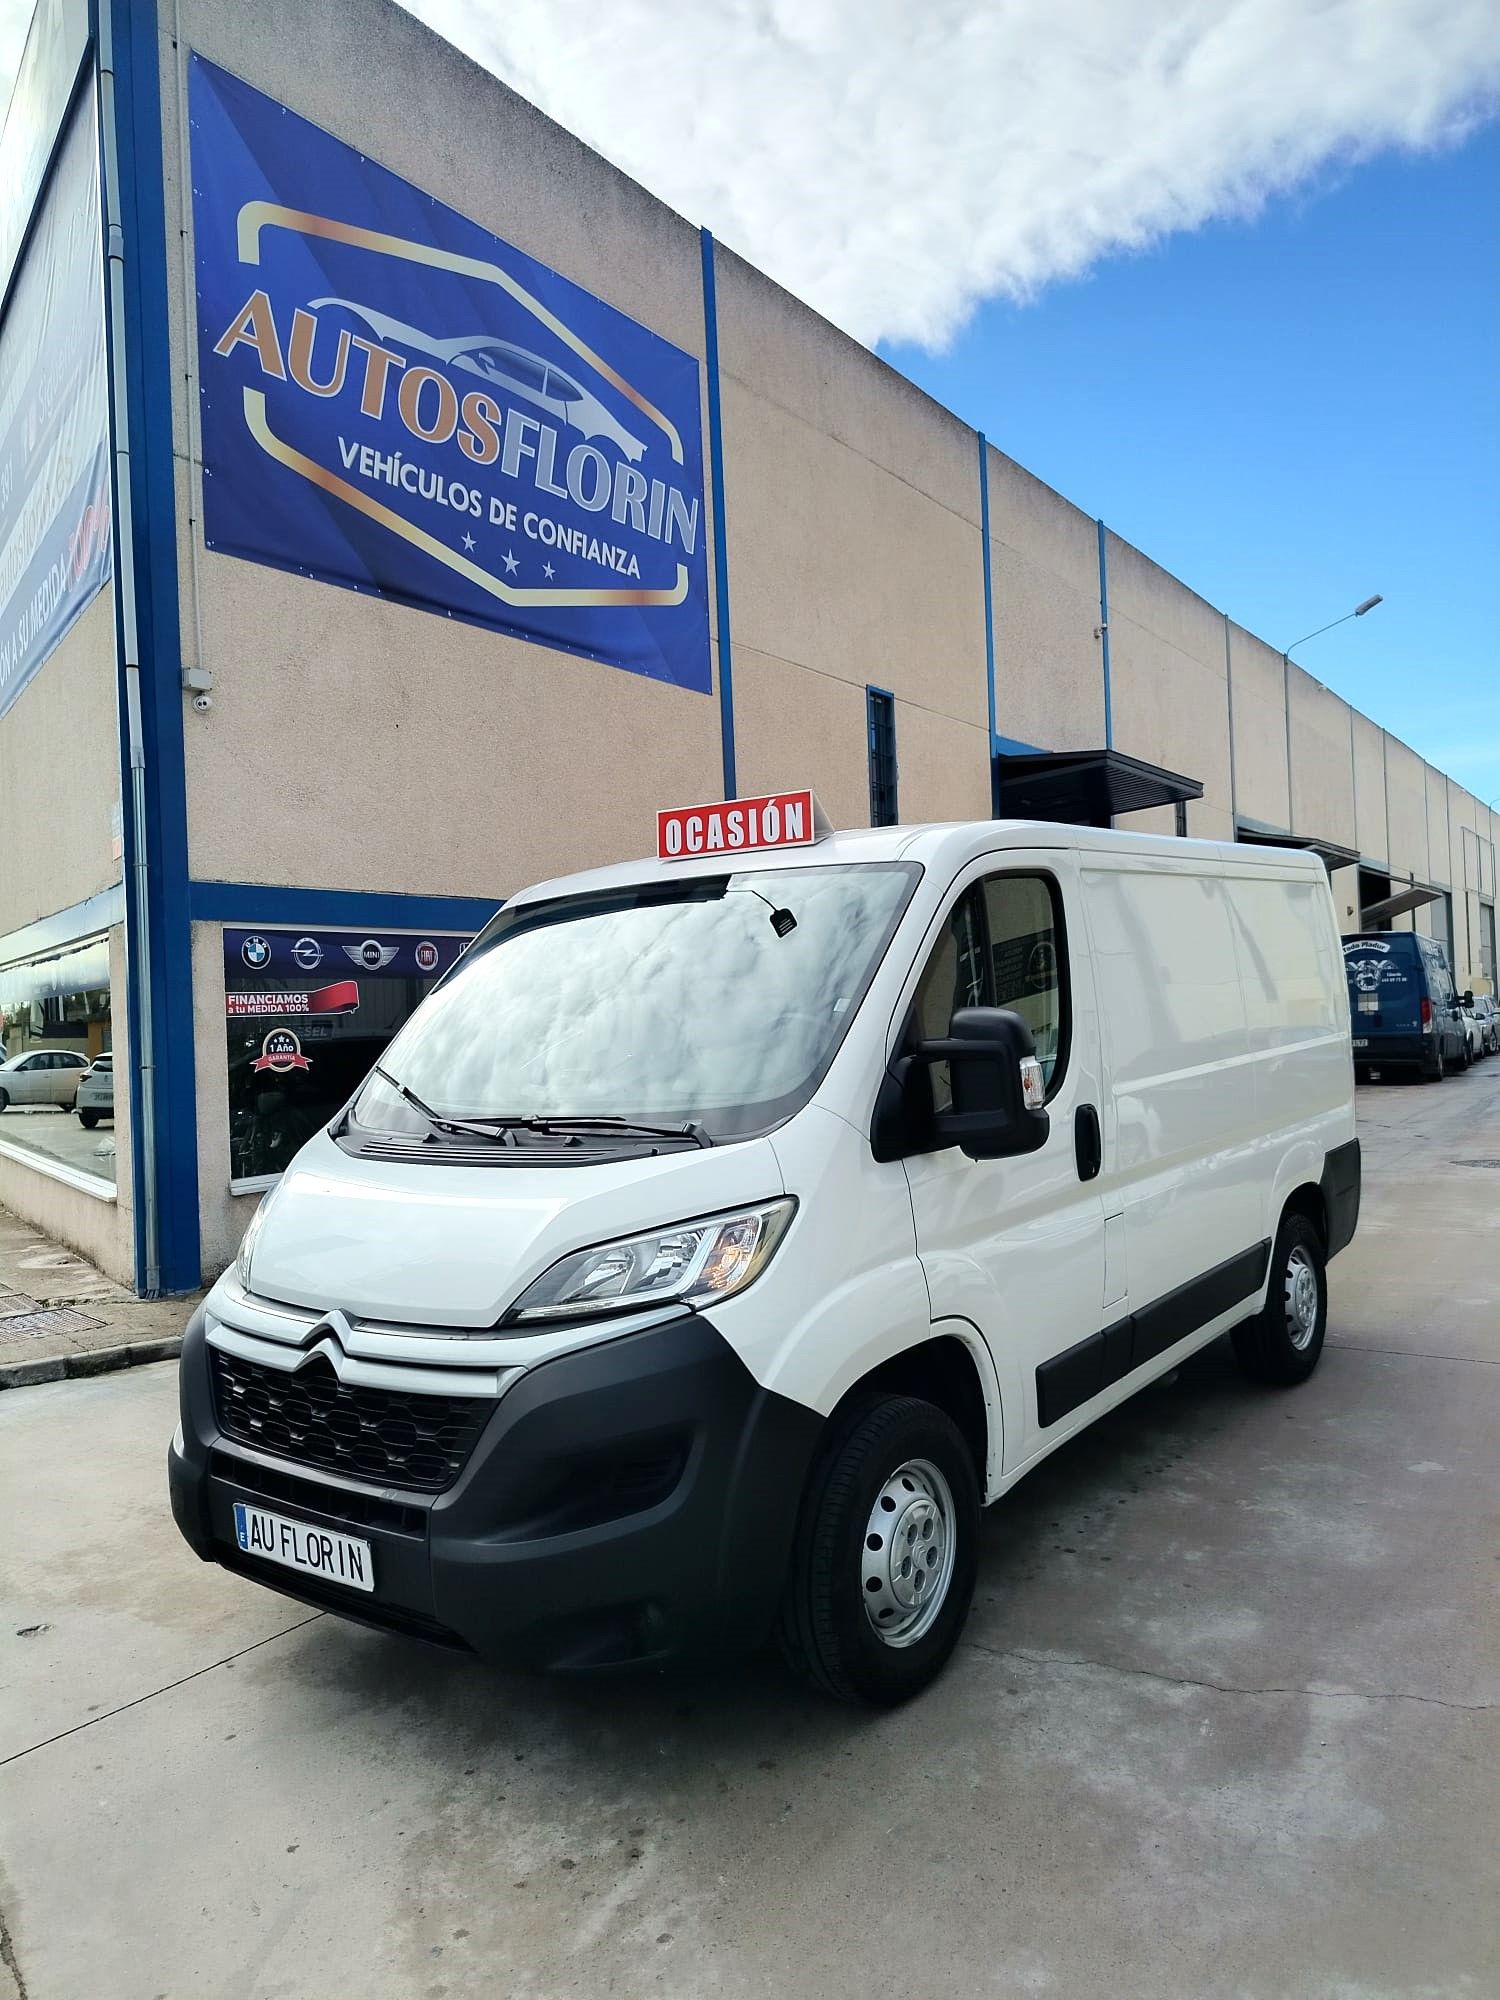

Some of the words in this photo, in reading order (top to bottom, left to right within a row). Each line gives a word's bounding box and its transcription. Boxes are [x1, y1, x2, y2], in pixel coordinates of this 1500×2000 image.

[338, 436, 482, 518] VEHÍCULOS
[489, 497, 516, 532] DE
[523, 513, 641, 580] CONFIANZA
[19, 609, 30, 653] SU
[31, 553, 67, 639] MEDIDA
[665, 799, 804, 855] OCASIÓN
[363, 951, 380, 959] MINI
[421, 950, 434, 962] FIAT
[228, 994, 309, 1005] FINANCIAMOS
[236, 1005, 246, 1013] tu
[247, 1004, 283, 1013] MEDIDA
[286, 1004, 310, 1012] 100%
[269, 1044, 275, 1053] 1
[276, 1043, 294, 1052] Año
[240, 1531, 246, 1542] E
[251, 1514, 275, 1552] AU
